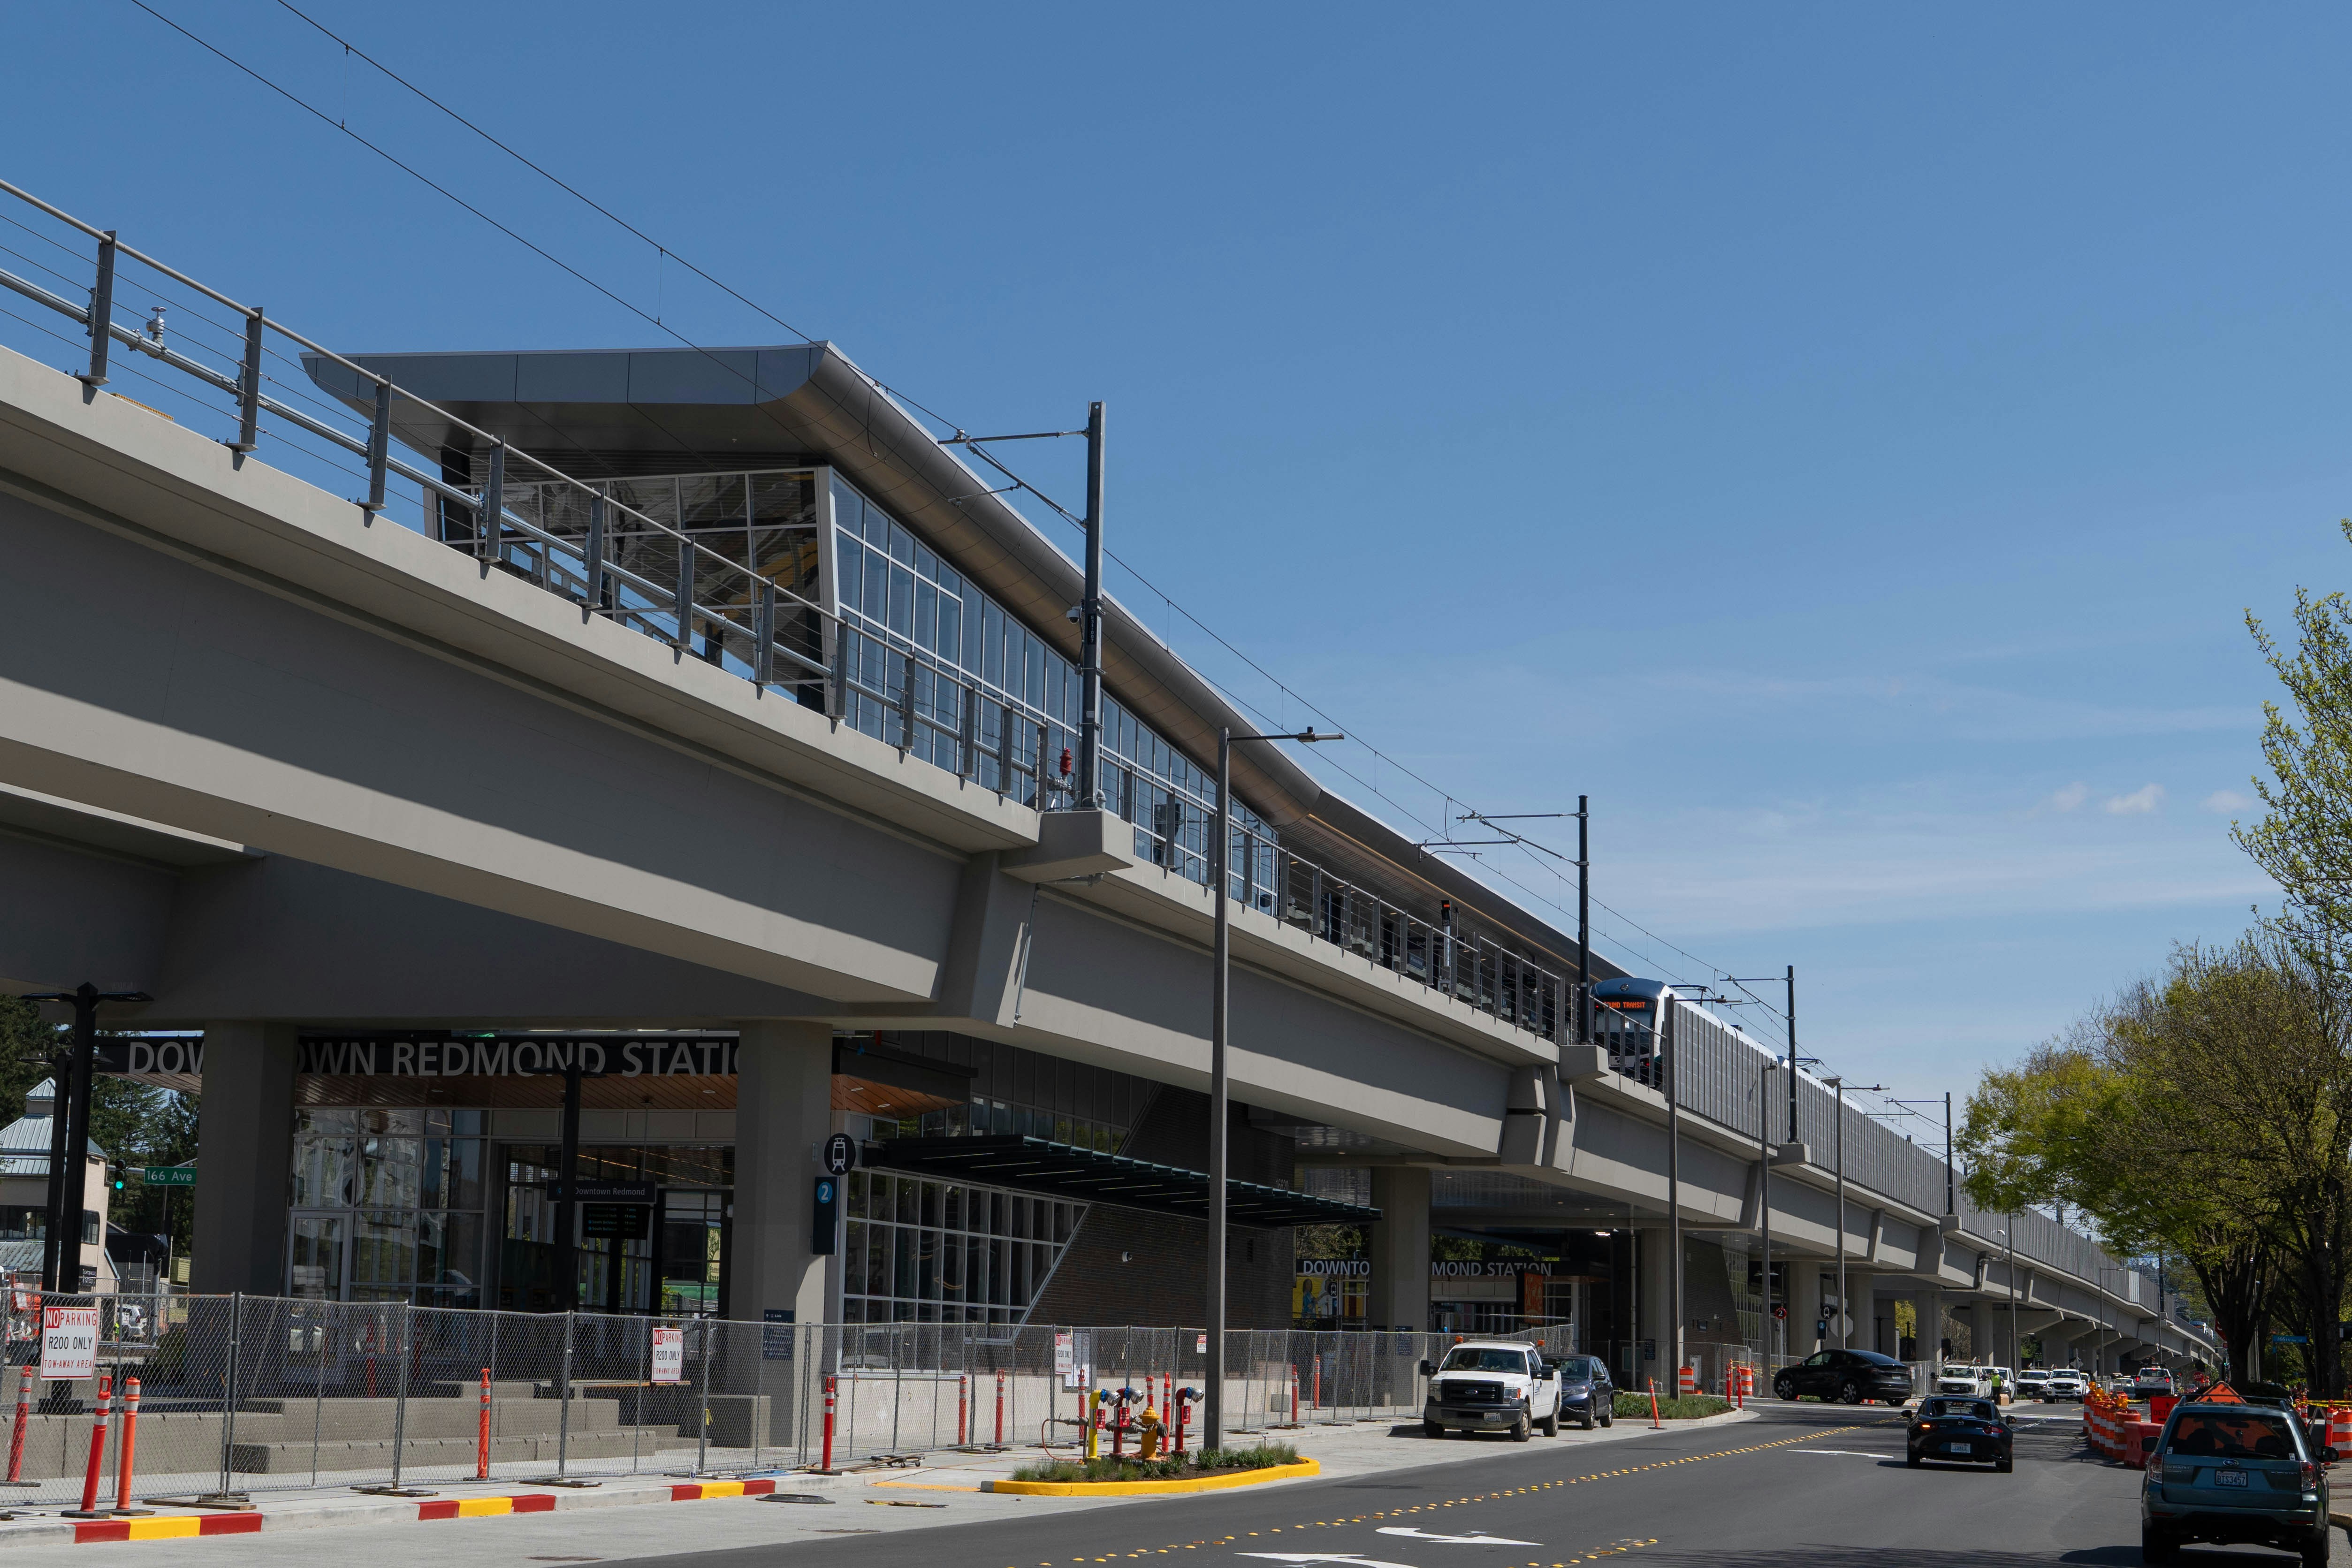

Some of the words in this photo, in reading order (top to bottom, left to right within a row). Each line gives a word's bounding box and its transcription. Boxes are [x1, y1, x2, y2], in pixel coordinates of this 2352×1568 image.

[392, 1042, 606, 1077] REDMOND
[622, 1042, 740, 1077] STATI
[147, 1171, 166, 1181] 166
[171, 1171, 192, 1181] Ave
[821, 1185, 829, 1201] 2
[46, 1309, 60, 1326] NO
[60, 1312, 97, 1326] PARKING
[49, 1336, 69, 1349] R200
[73, 1337, 93, 1349] ONLY
[655, 1331, 662, 1343] NO
[662, 1333, 682, 1343] PARKING
[656, 1350, 667, 1360] R200
[669, 1351, 680, 1360] ONLY
[45, 1360, 74, 1368] TOW-AWAY
[76, 1360, 92, 1368] AREA
